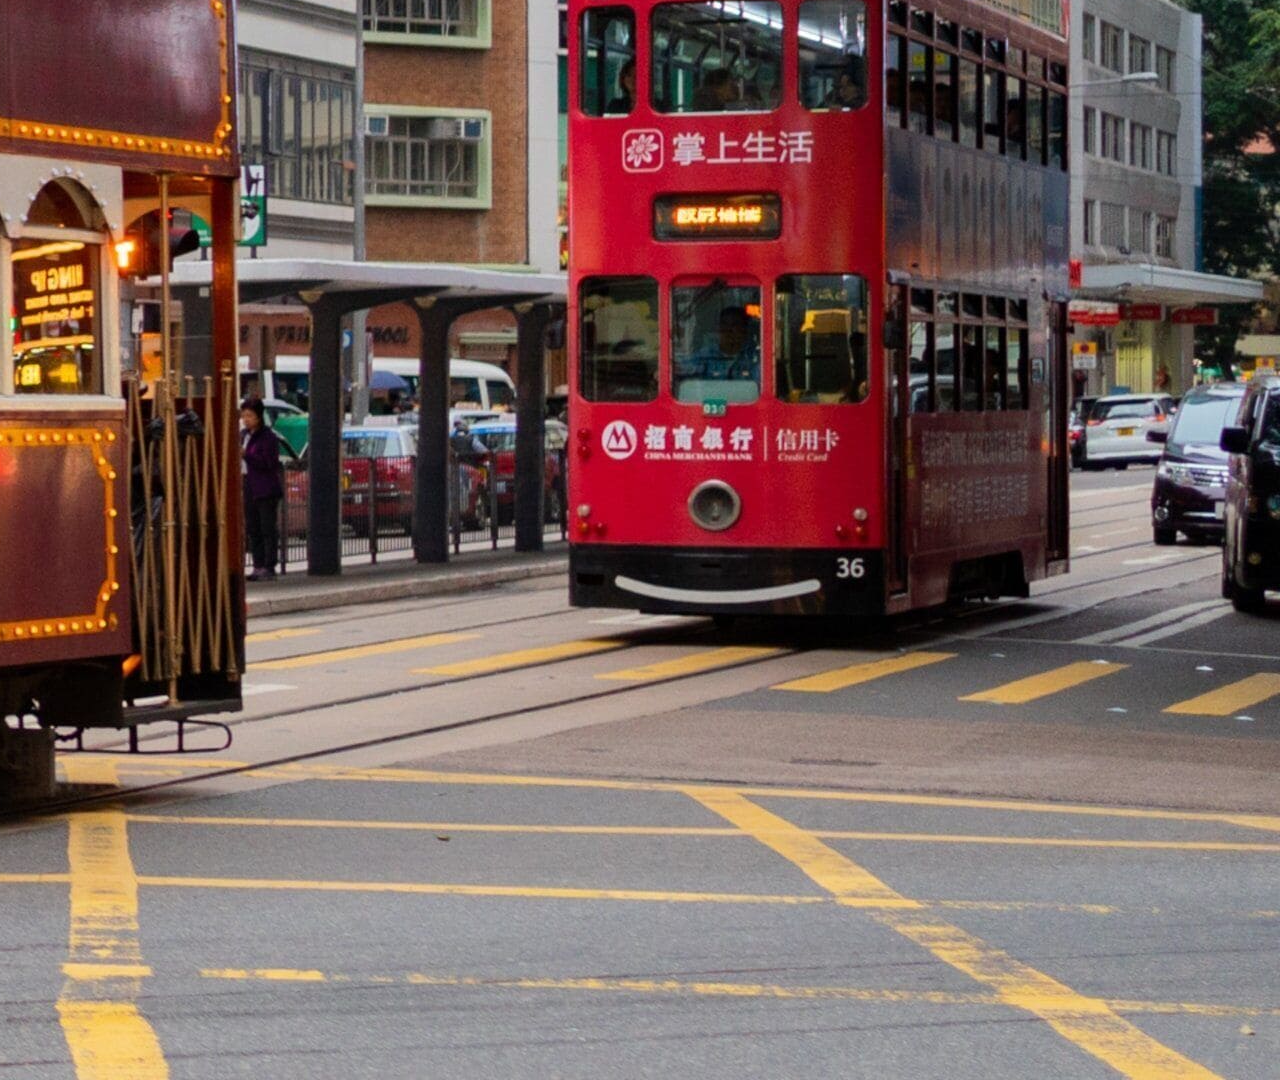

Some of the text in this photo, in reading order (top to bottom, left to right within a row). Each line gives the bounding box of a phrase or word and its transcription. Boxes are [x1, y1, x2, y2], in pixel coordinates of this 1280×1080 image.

[671, 130, 815, 167] 掌上生活
[643, 424, 840, 452] 招商銀行 信用卡
[643, 452, 671, 461] CHINA
[728, 452, 753, 461] BANK
[807, 452, 828, 462] Card
[836, 557, 865, 579] 36
